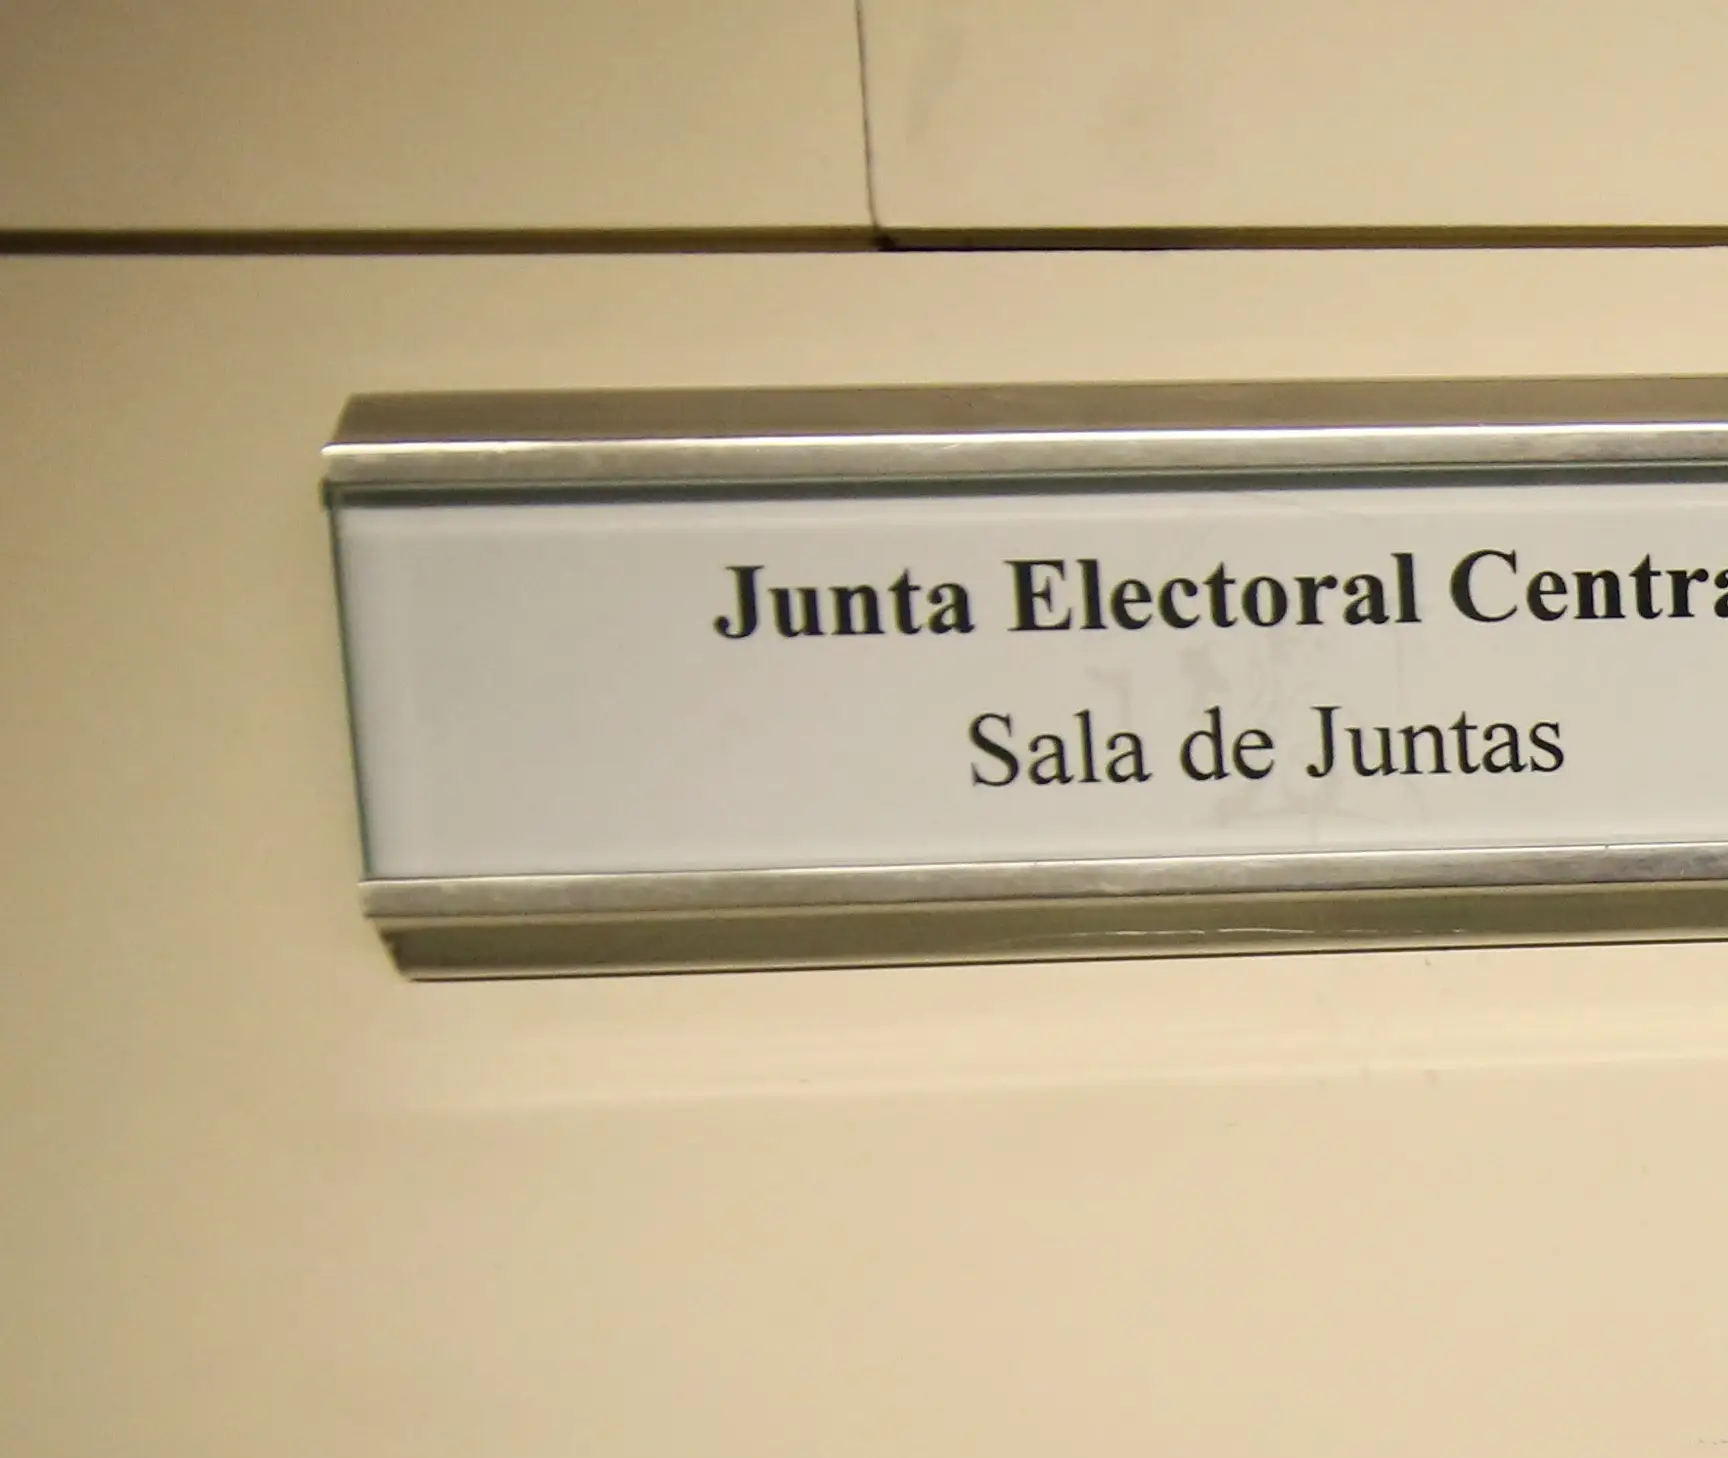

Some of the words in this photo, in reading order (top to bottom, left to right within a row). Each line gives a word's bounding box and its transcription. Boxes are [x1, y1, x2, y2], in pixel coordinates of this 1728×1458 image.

[713, 563, 976, 640] Junta
[1004, 551, 1423, 633] Electoral
[968, 708, 1153, 788] Sala
[1179, 704, 1275, 783] de
[1305, 703, 1565, 780] Juntas
